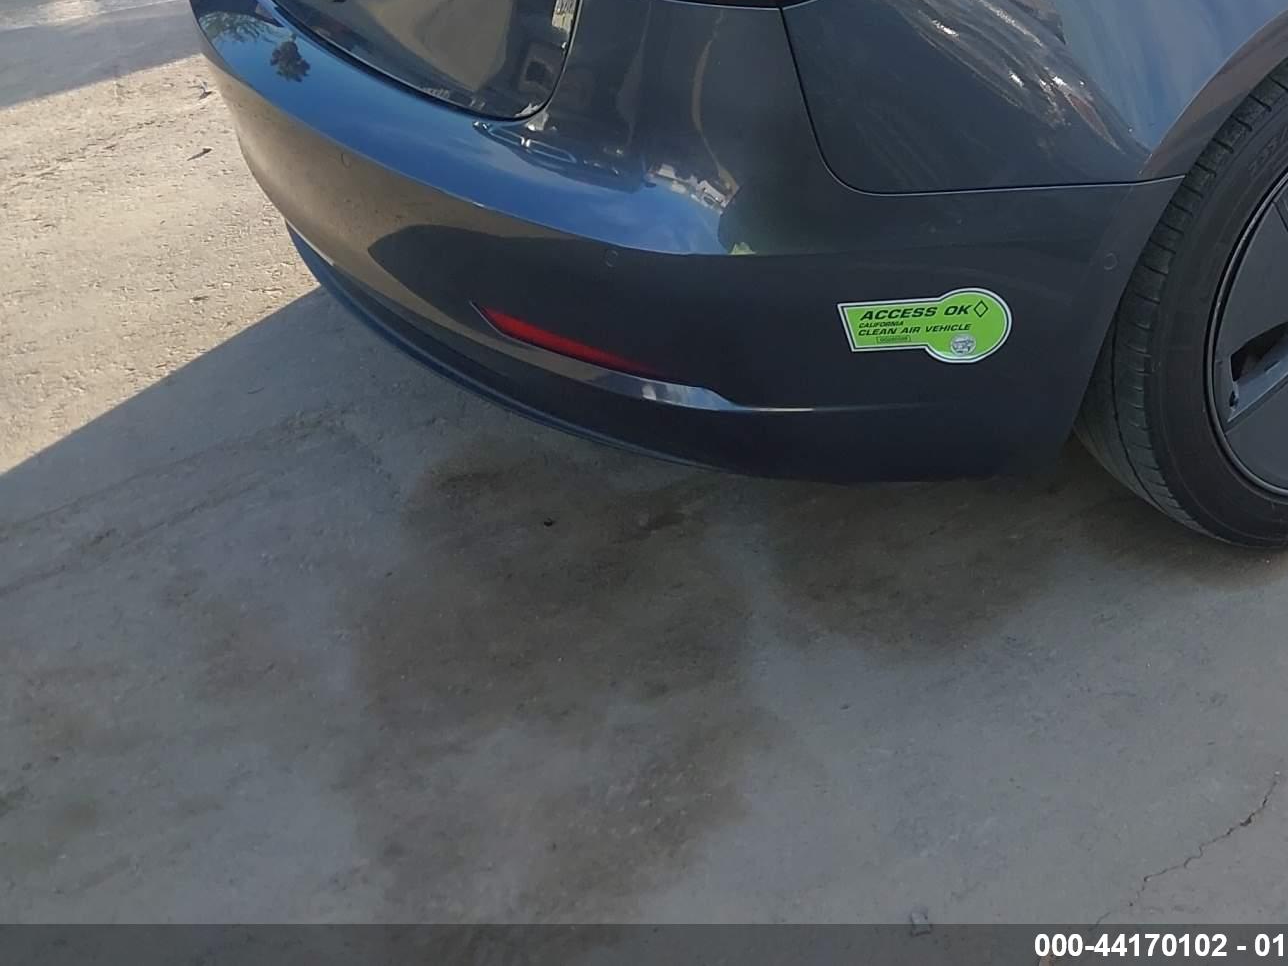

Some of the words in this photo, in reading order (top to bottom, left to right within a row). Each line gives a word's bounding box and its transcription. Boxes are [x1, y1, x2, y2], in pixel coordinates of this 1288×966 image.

[860, 307, 938, 320] ACCESS
[943, 304, 974, 316] OK
[858, 328, 898, 337] CLEAN
[900, 326, 921, 335] AIR
[925, 324, 971, 333] VEHICLE
[859, 320, 904, 329] CALIFORNIA
